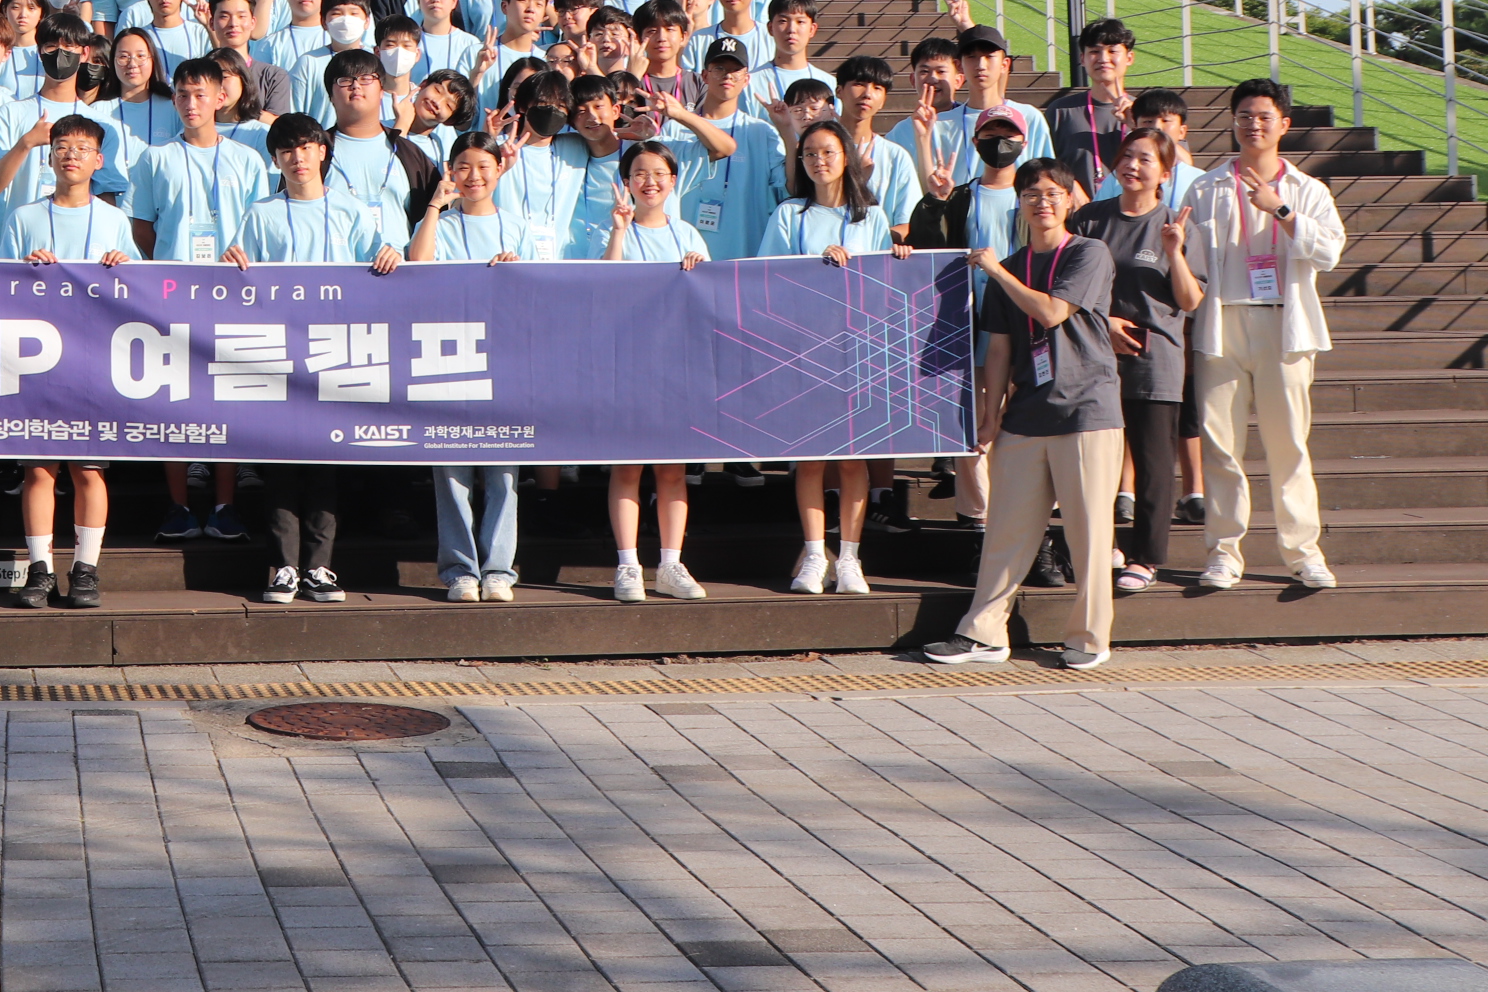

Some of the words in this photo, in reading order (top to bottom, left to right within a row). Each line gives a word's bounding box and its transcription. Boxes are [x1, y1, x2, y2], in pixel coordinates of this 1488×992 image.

[162, 279, 342, 306] Program
[110, 322, 494, 403] 여름캠프
[97, 421, 118, 442] 및
[123, 422, 228, 444] 궁리실험실
[354, 425, 412, 440] KAIST
[423, 425, 535, 439] 과학영재교육연구원
[423, 441, 443, 449] Global
[443, 441, 468, 449] Institute
[479, 441, 504, 449] Talented
